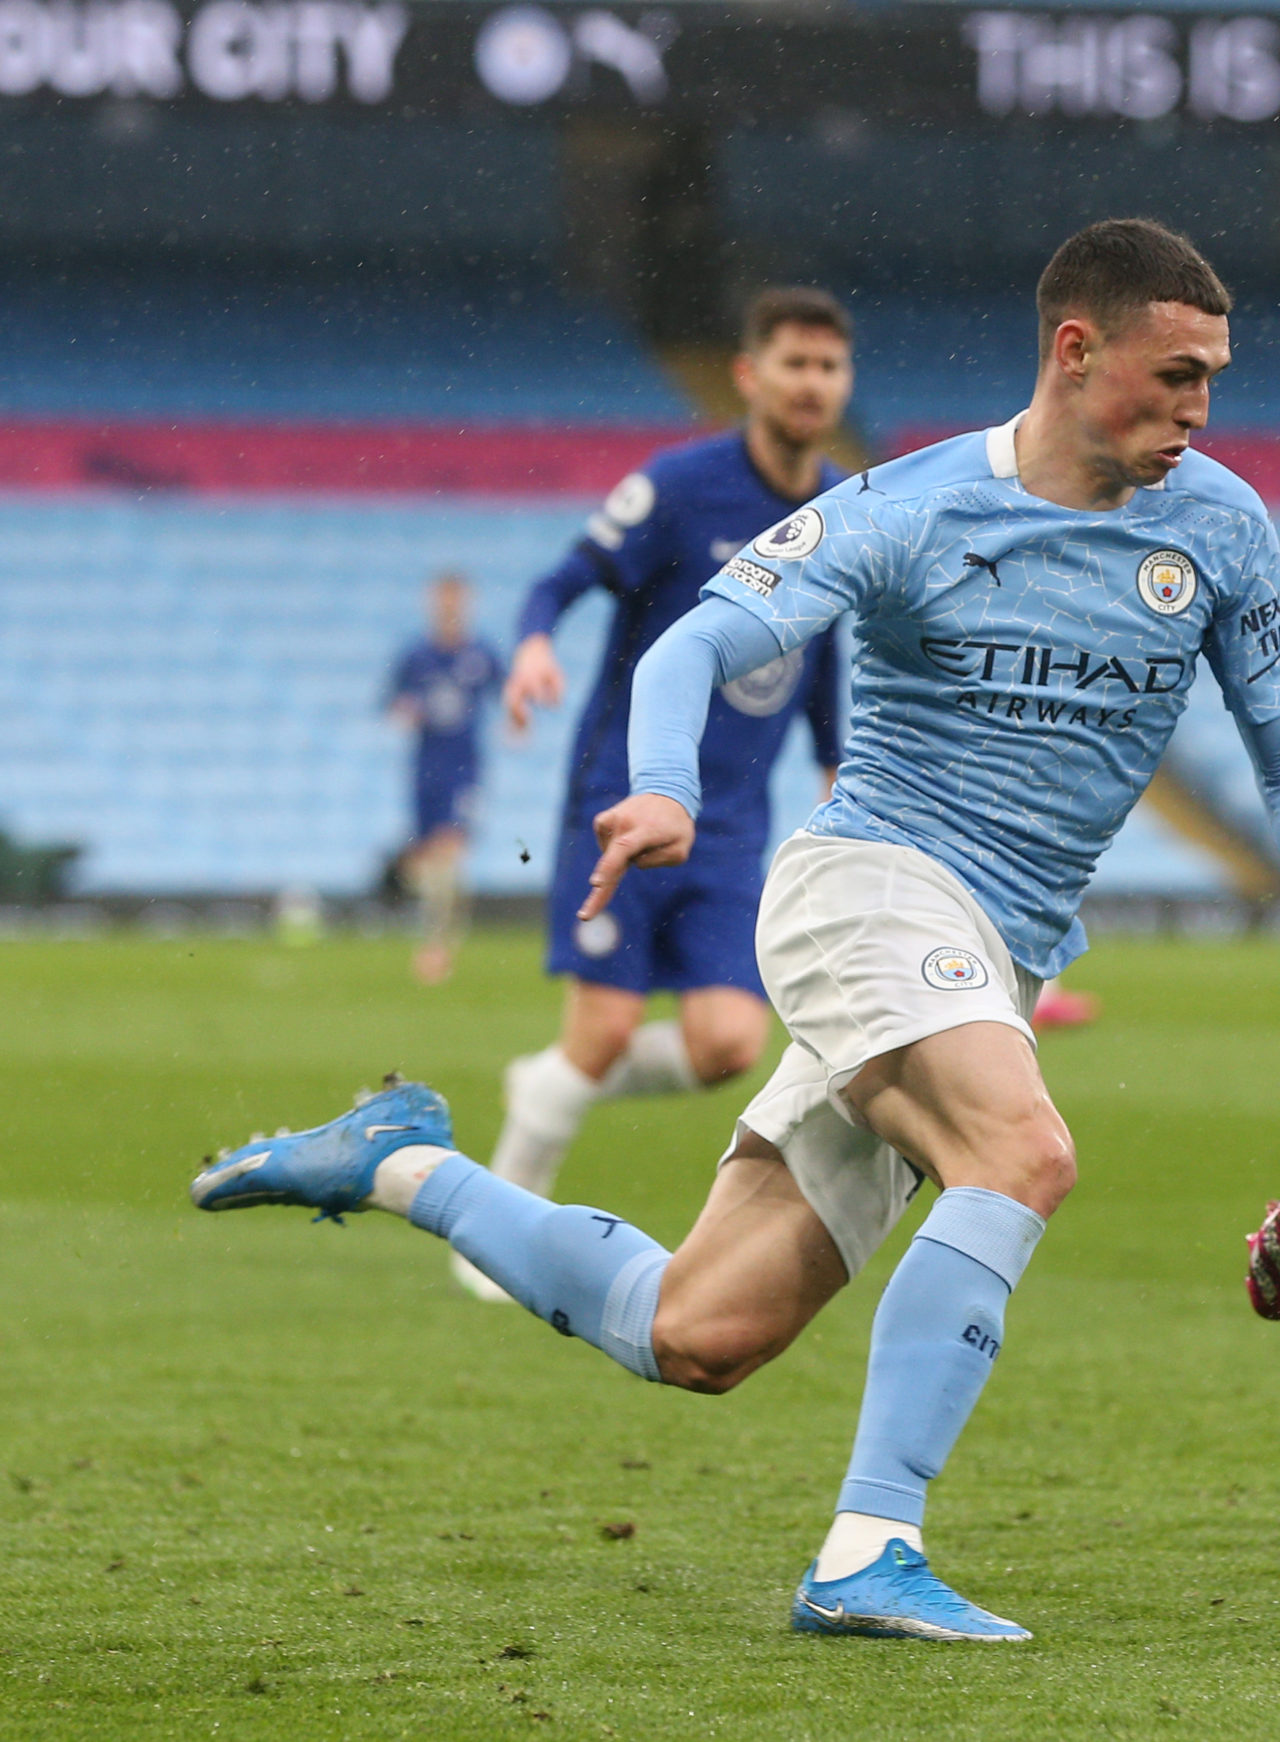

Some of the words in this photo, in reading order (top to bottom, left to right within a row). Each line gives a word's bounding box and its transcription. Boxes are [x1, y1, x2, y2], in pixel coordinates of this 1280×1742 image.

[189, 0, 405, 102] CITY
[962, 11, 1181, 119] THIS
[1143, 552, 1192, 575] MANCHESTER
[1158, 604, 1176, 612] CITY
[921, 637, 1186, 693] ETIHAD
[956, 691, 1138, 729] AIRWAYS
